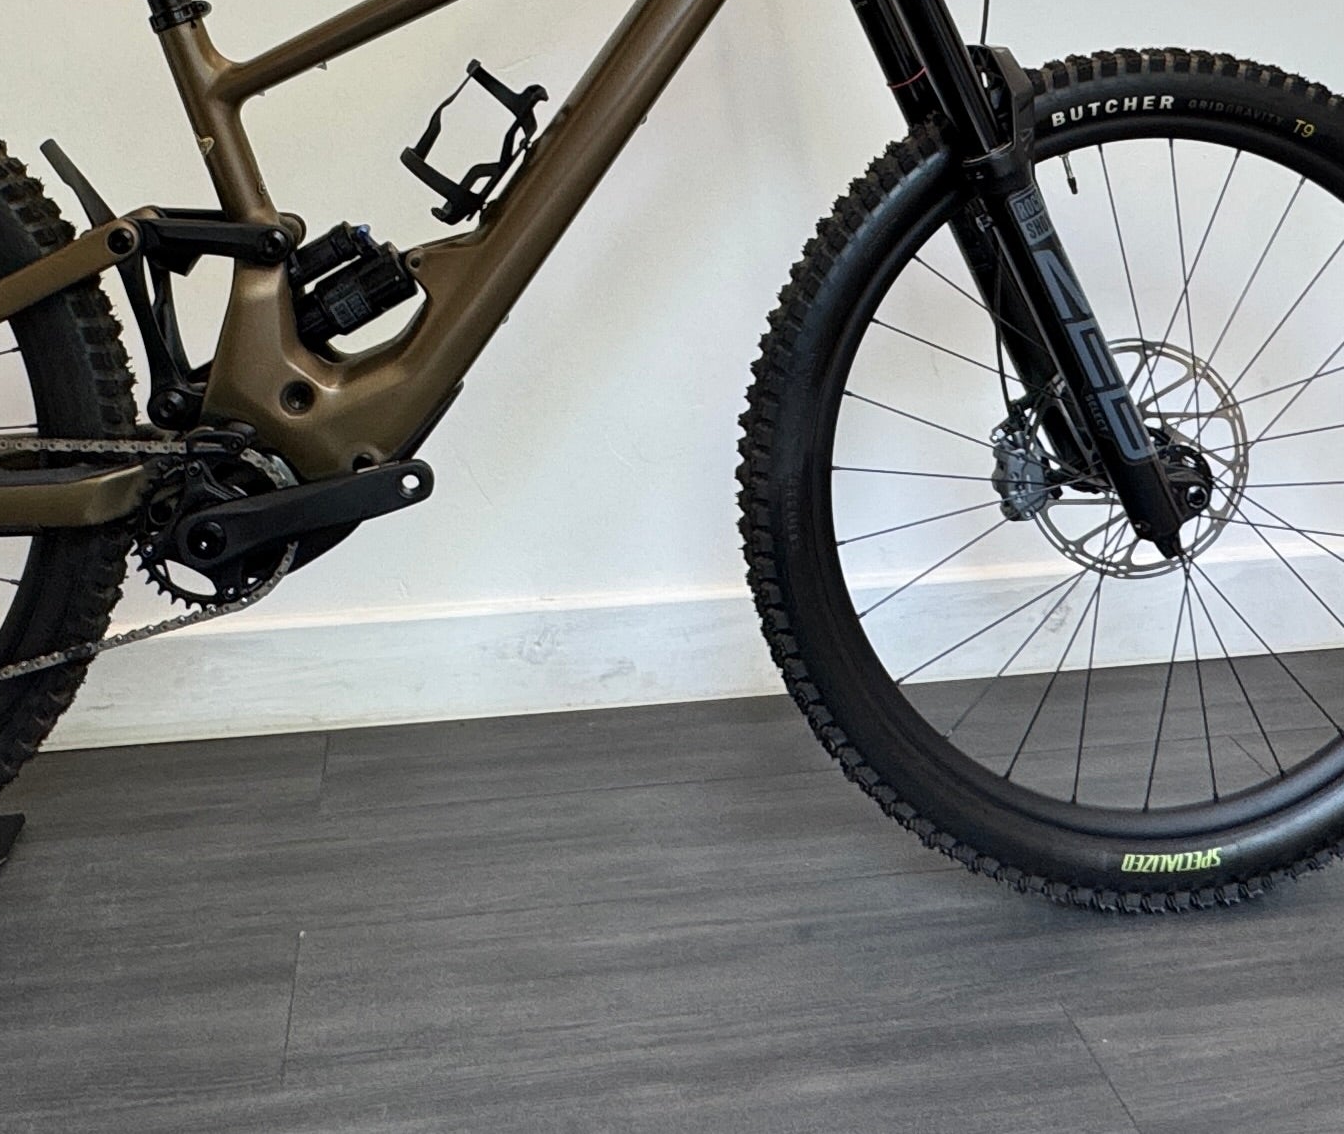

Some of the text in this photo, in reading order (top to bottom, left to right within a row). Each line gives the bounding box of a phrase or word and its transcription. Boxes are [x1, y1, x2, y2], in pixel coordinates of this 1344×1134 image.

[1051, 94, 1176, 128] BUTCHER
[1292, 117, 1316, 138] T9
[1120, 847, 1223, 873] SPECIALIZED
